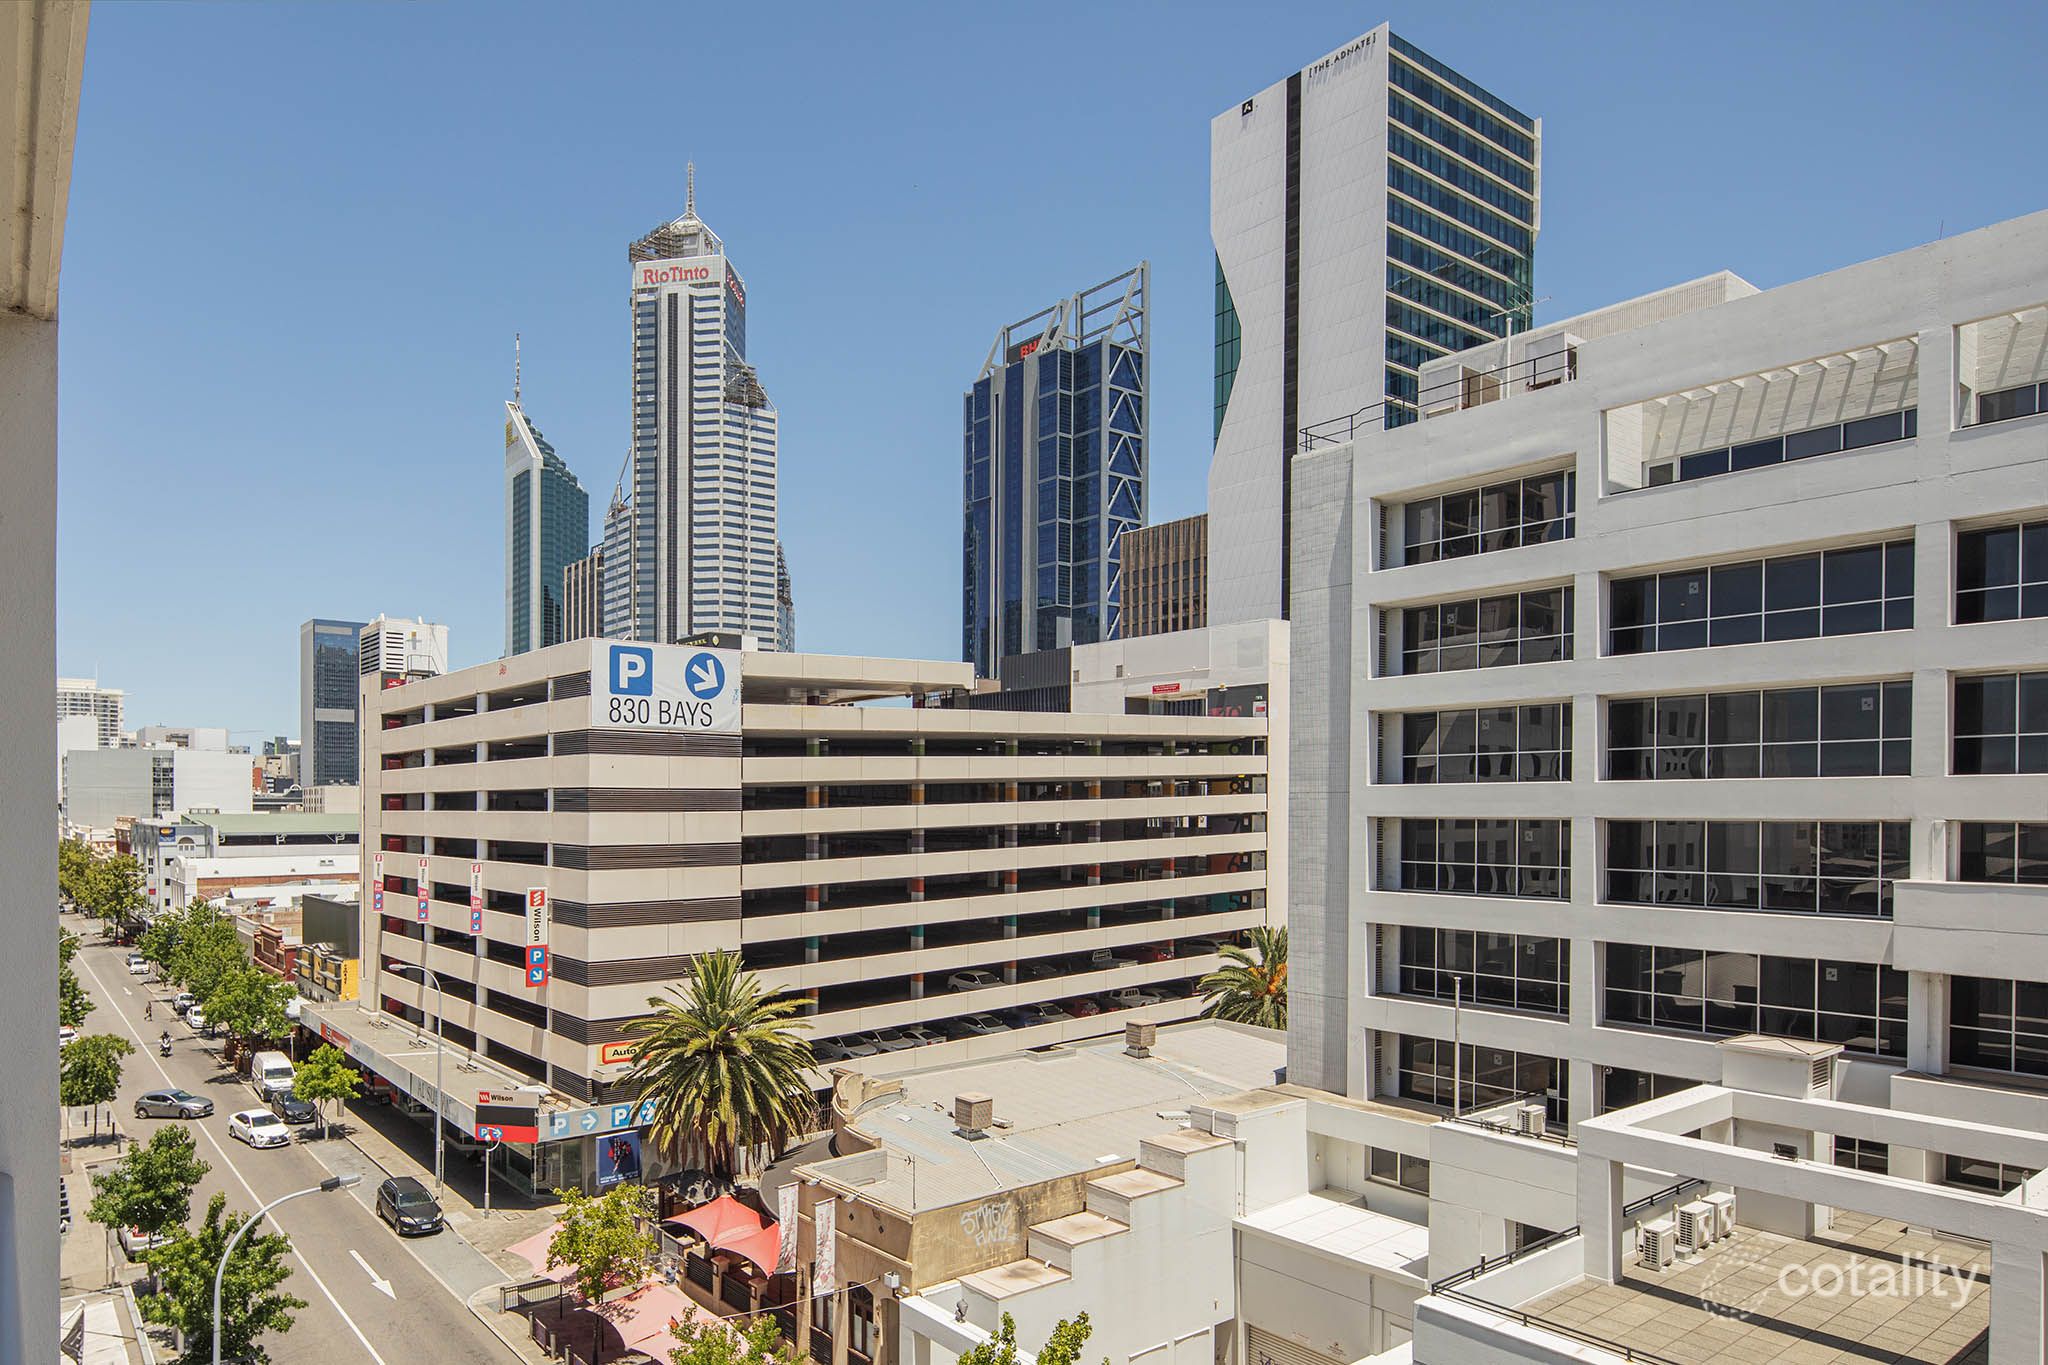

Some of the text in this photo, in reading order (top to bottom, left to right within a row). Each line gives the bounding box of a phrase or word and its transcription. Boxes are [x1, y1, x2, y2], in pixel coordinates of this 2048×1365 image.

[619, 652, 646, 689] P
[609, 697, 712, 727] 830 BAYS
[533, 908, 542, 942] Wilson
[533, 950, 542, 962] P
[491, 1094, 513, 1102] Wilson
[615, 1108, 627, 1125] P
[554, 1118, 567, 1134] P
